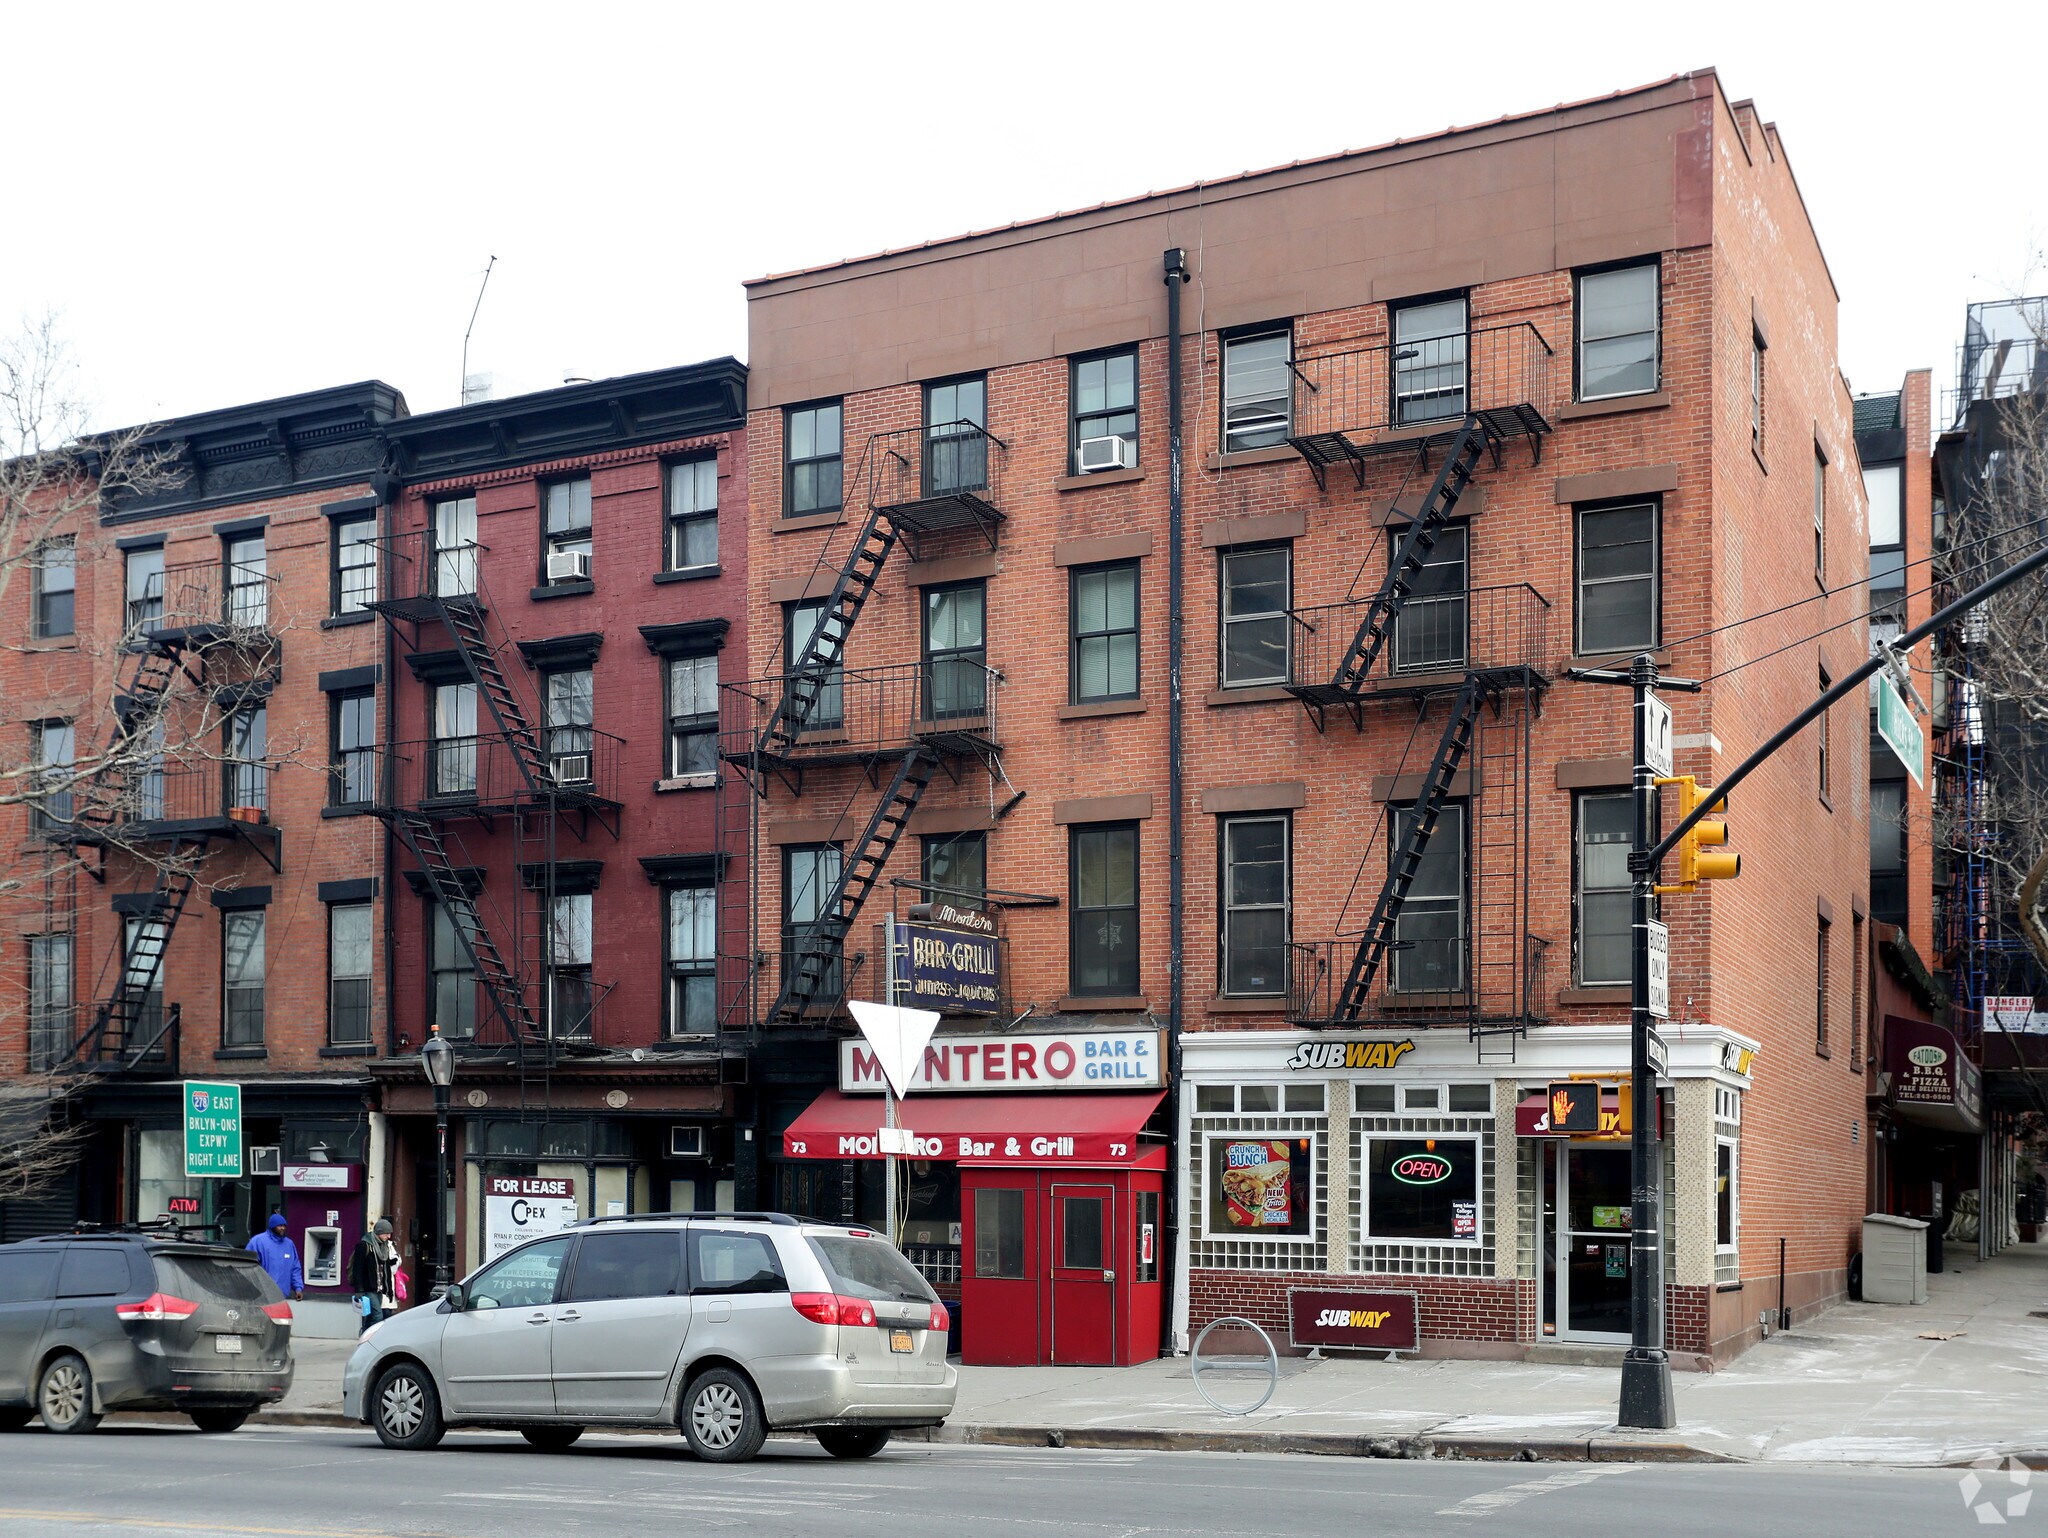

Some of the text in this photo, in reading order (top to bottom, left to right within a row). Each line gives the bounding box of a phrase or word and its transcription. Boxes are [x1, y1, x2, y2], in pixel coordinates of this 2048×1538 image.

[1646, 744, 1671, 773] ONLY ONLY
[936, 904, 993, 932] Montero
[1650, 929, 1667, 954] BUSES
[1651, 957, 1666, 981] ONLY
[1650, 985, 1667, 1010] SIGNAL
[1085, 1041, 1128, 1058] BAR
[1287, 1039, 1415, 1071] SUBWAY
[1913, 1049, 1942, 1064] FATOOSH
[852, 1041, 1076, 1082] MNTERO
[1085, 1062, 1148, 1079] GRILL
[1913, 1066, 1947, 1076] B.B.Q.
[1912, 1077, 1948, 1087] PIZZA
[194, 1096, 234, 1110] 278 EAST
[471, 1092, 485, 1105] 71
[609, 1092, 623, 1105] 71
[199, 1134, 228, 1147] EXPWY
[792, 1136, 1127, 1156] 73 MORO Bar & Grill 73
[1229, 1145, 1260, 1153] CRUNCH
[189, 1153, 238, 1167] RIGHT LANE
[1229, 1154, 1268, 1165] BUNCH
[1400, 1160, 1444, 1178] OPEN
[493, 1179, 567, 1194] FOR LEASE
[170, 1199, 198, 1212] ATM
[511, 1199, 546, 1226] CPEX
[1315, 1309, 1391, 1328] SUBWAY
